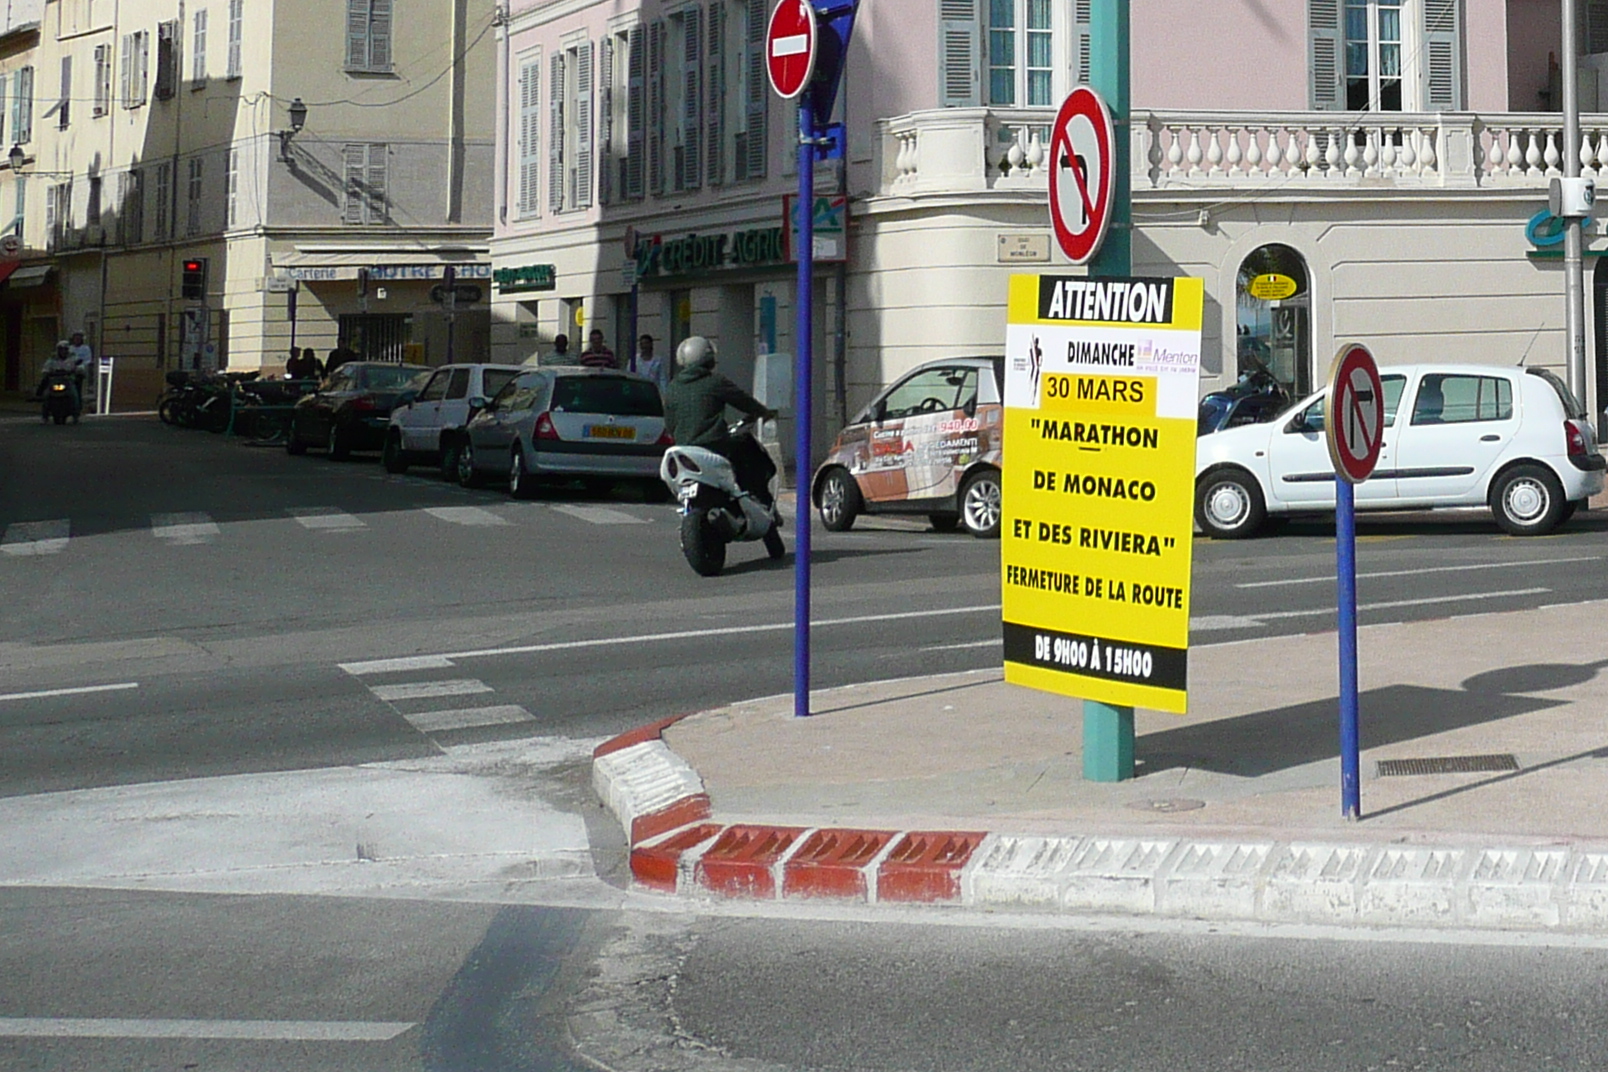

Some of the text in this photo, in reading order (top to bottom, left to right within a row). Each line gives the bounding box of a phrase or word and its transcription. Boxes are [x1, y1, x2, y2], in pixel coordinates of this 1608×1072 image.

[661, 233, 727, 272] CRÉDIT
[1048, 281, 1167, 322] ATTENTION
[1067, 341, 1135, 366] DIMANCHE
[1153, 348, 1198, 364] Menton
[1047, 377, 1144, 402] 30 MARS
[1034, 470, 1156, 501] DE MONACO
[1013, 519, 1032, 539] ET
[1038, 522, 1072, 545] DES
[1007, 565, 1183, 609] FERMETURE DE LA ROUTE
[1035, 635, 1152, 678] DE 9H00 À 15H00
